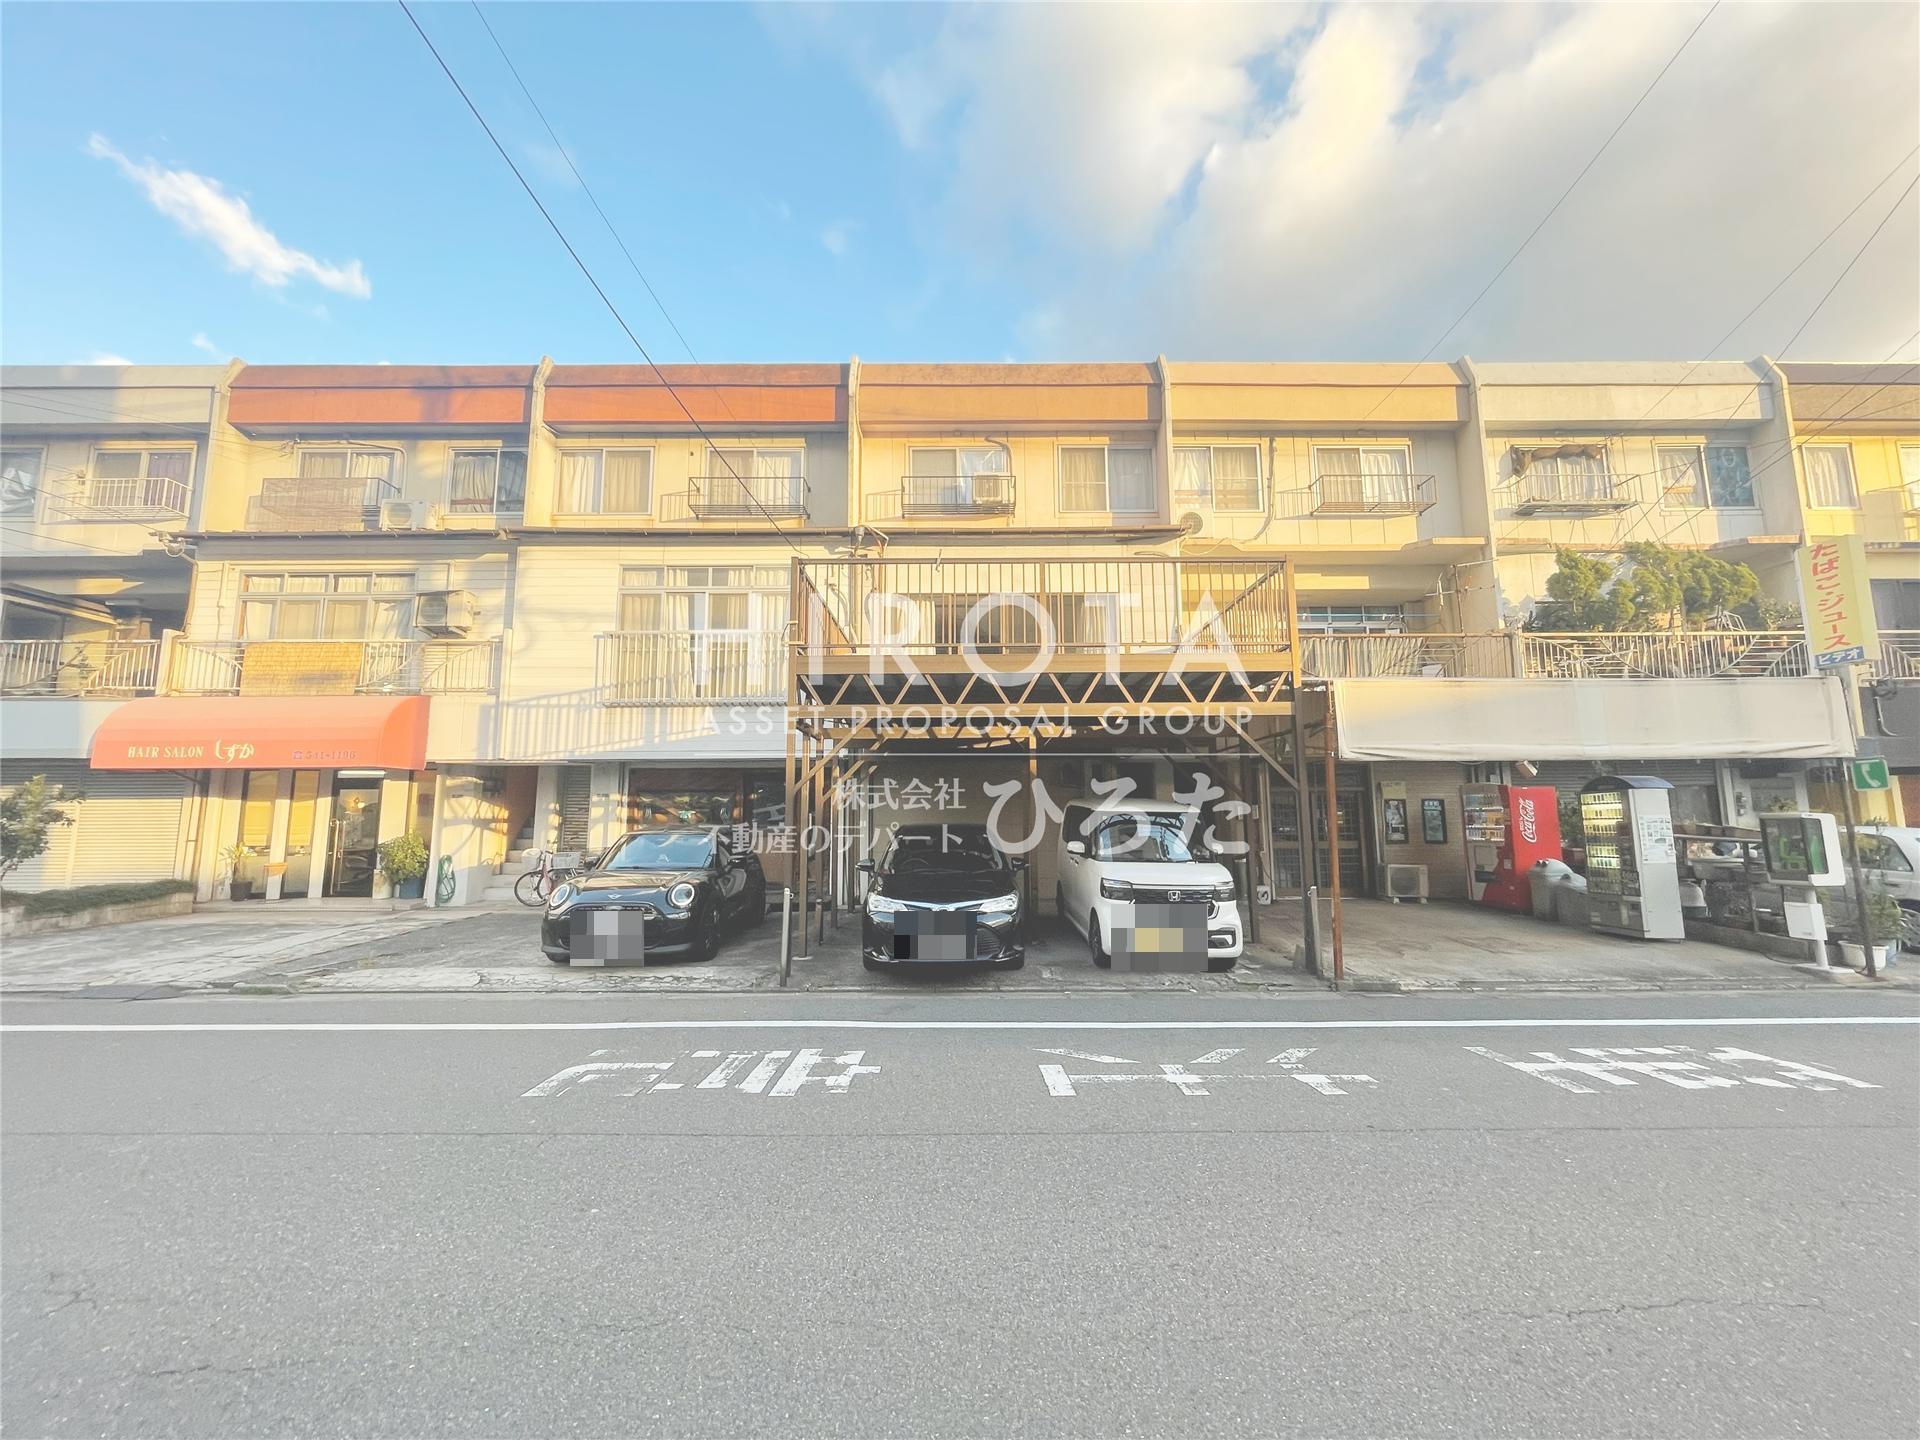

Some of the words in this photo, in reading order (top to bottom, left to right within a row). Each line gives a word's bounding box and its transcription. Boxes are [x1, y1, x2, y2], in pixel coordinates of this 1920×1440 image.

[1818, 648, 1860, 664] ビデオ
[127, 746, 160, 758] HAIR
[163, 746, 205, 758] SALON
